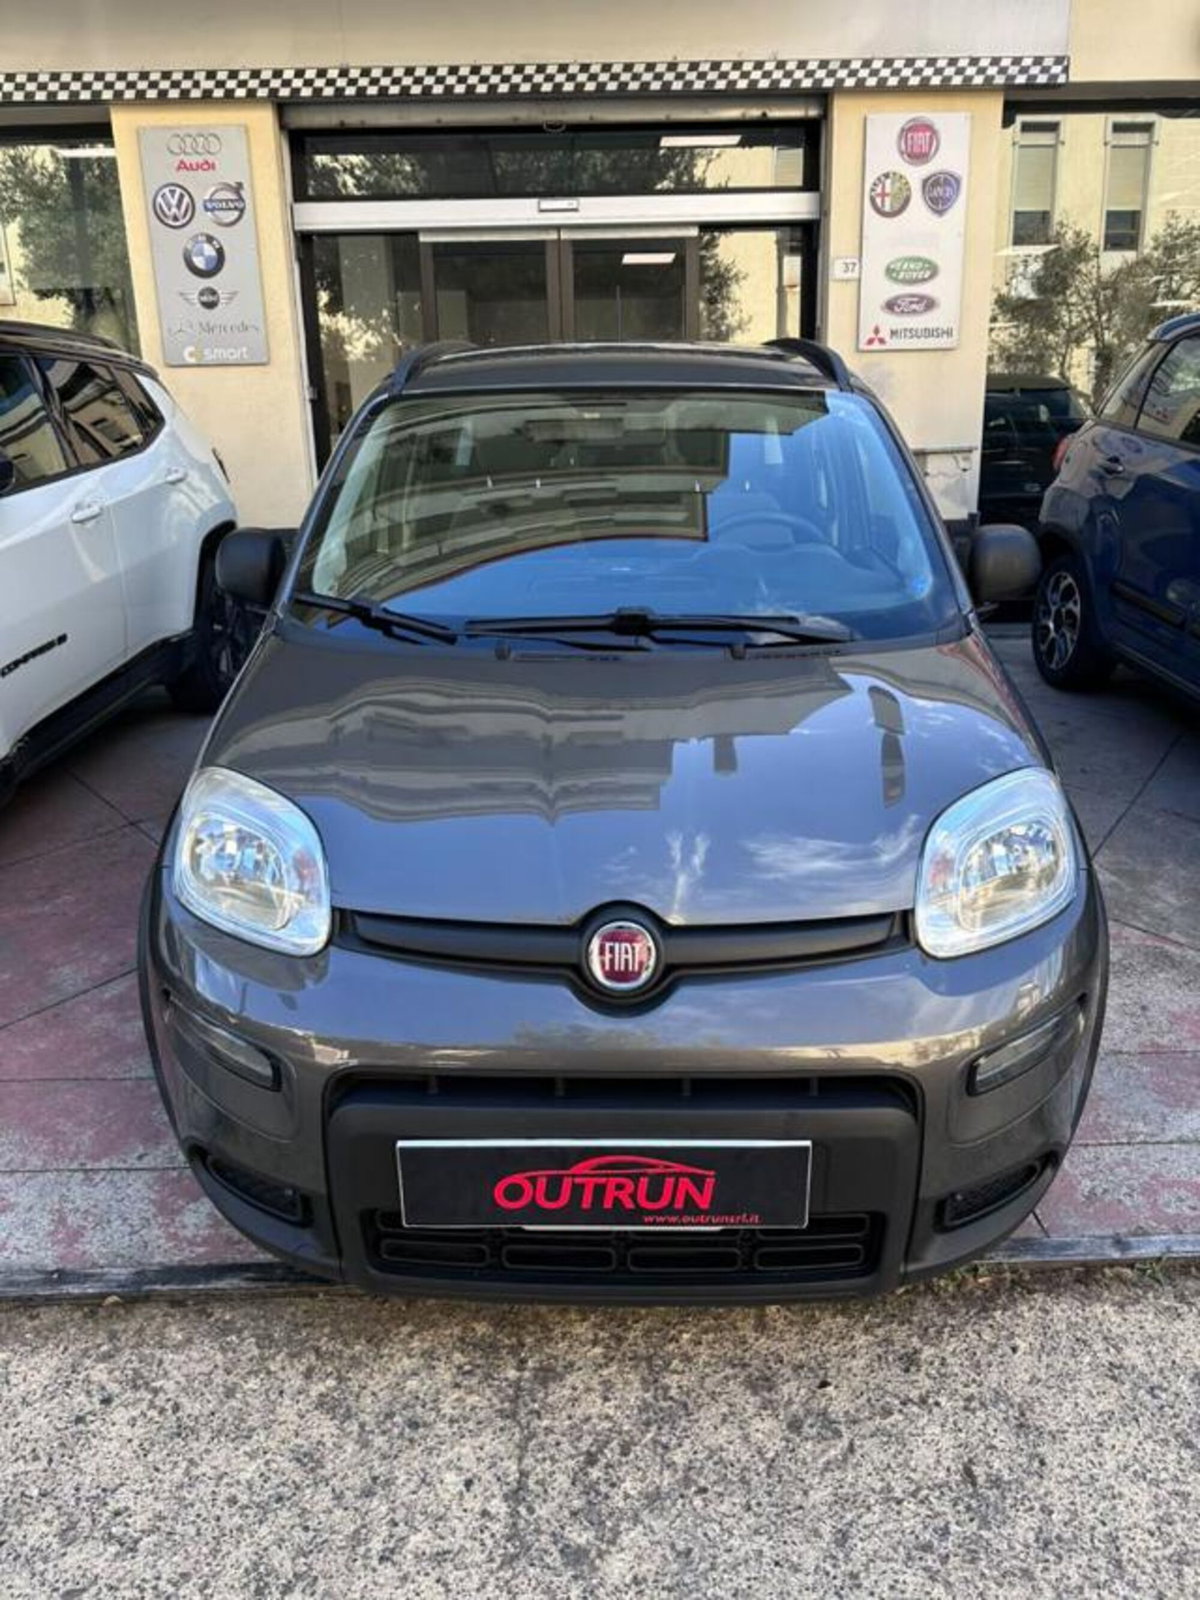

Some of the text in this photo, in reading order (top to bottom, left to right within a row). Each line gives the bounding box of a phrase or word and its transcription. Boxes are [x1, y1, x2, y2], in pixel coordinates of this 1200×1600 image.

[906, 131, 932, 153] FIAT
[175, 159, 216, 172] Audi
[205, 200, 245, 211] VOLVO
[843, 262, 857, 273] 37
[894, 298, 928, 312] Ford
[890, 326, 953, 339] MITSUBISHI
[203, 346, 248, 360] smart
[604, 942, 642, 972] FIAT
[494, 1175, 716, 1210] OUTRUN
[643, 1213, 760, 1225] www.outrunsrl.it
